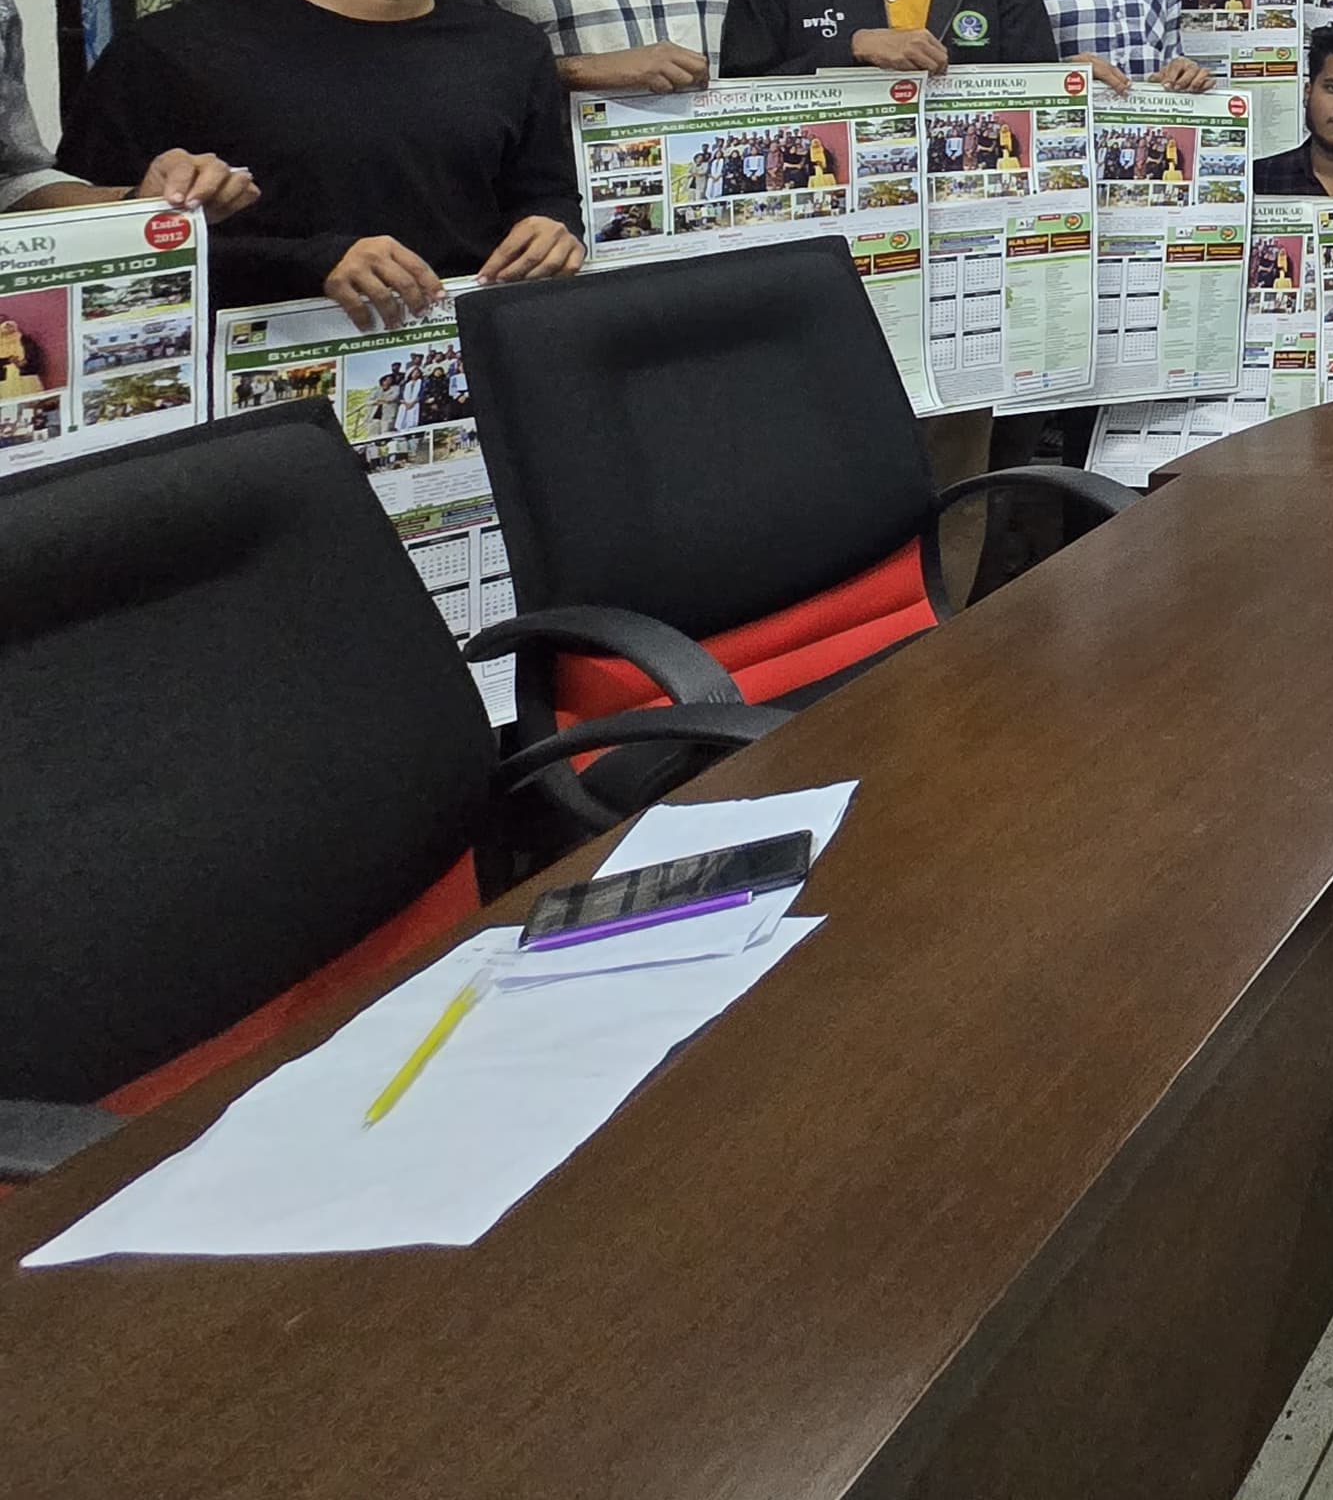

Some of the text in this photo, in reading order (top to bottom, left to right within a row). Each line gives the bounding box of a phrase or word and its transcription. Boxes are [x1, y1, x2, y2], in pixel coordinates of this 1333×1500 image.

[751, 87, 842, 105] (PRADHIKAR)
[101, 258, 158, 274] 3100
[339, 329, 449, 352] AGRICULTURAL
